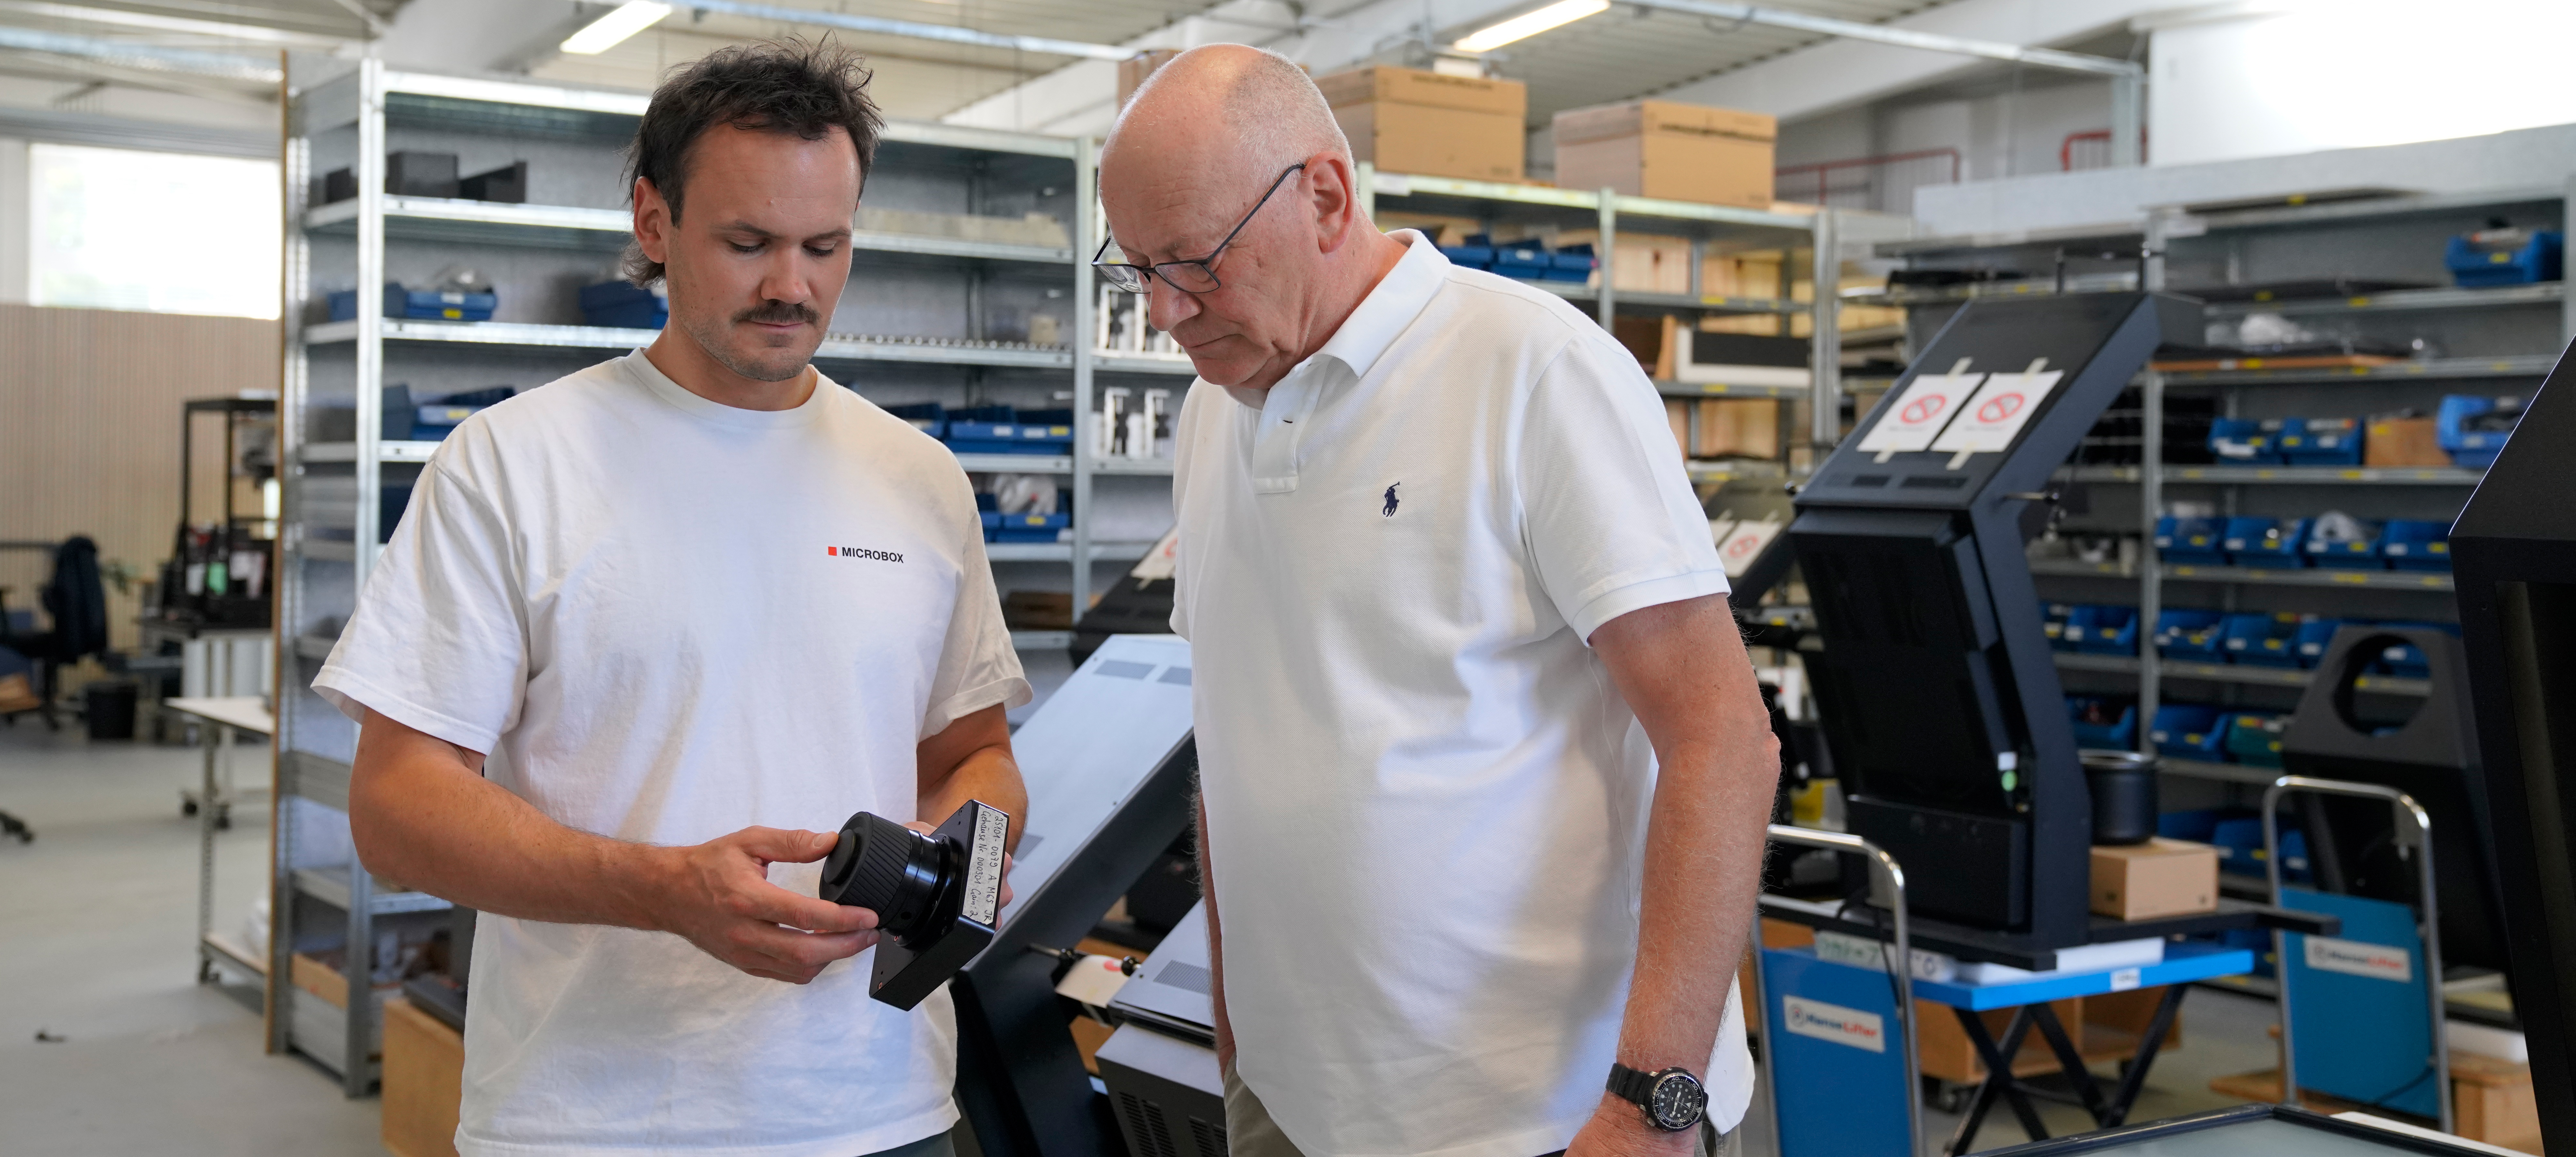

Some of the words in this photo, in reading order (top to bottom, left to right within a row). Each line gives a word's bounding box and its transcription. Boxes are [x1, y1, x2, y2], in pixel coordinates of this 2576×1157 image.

[842, 547, 903, 563] MICROBOX
[978, 844, 988, 854] Nr.
[974, 857, 984, 884] 000301
[986, 887, 996, 904] M65
